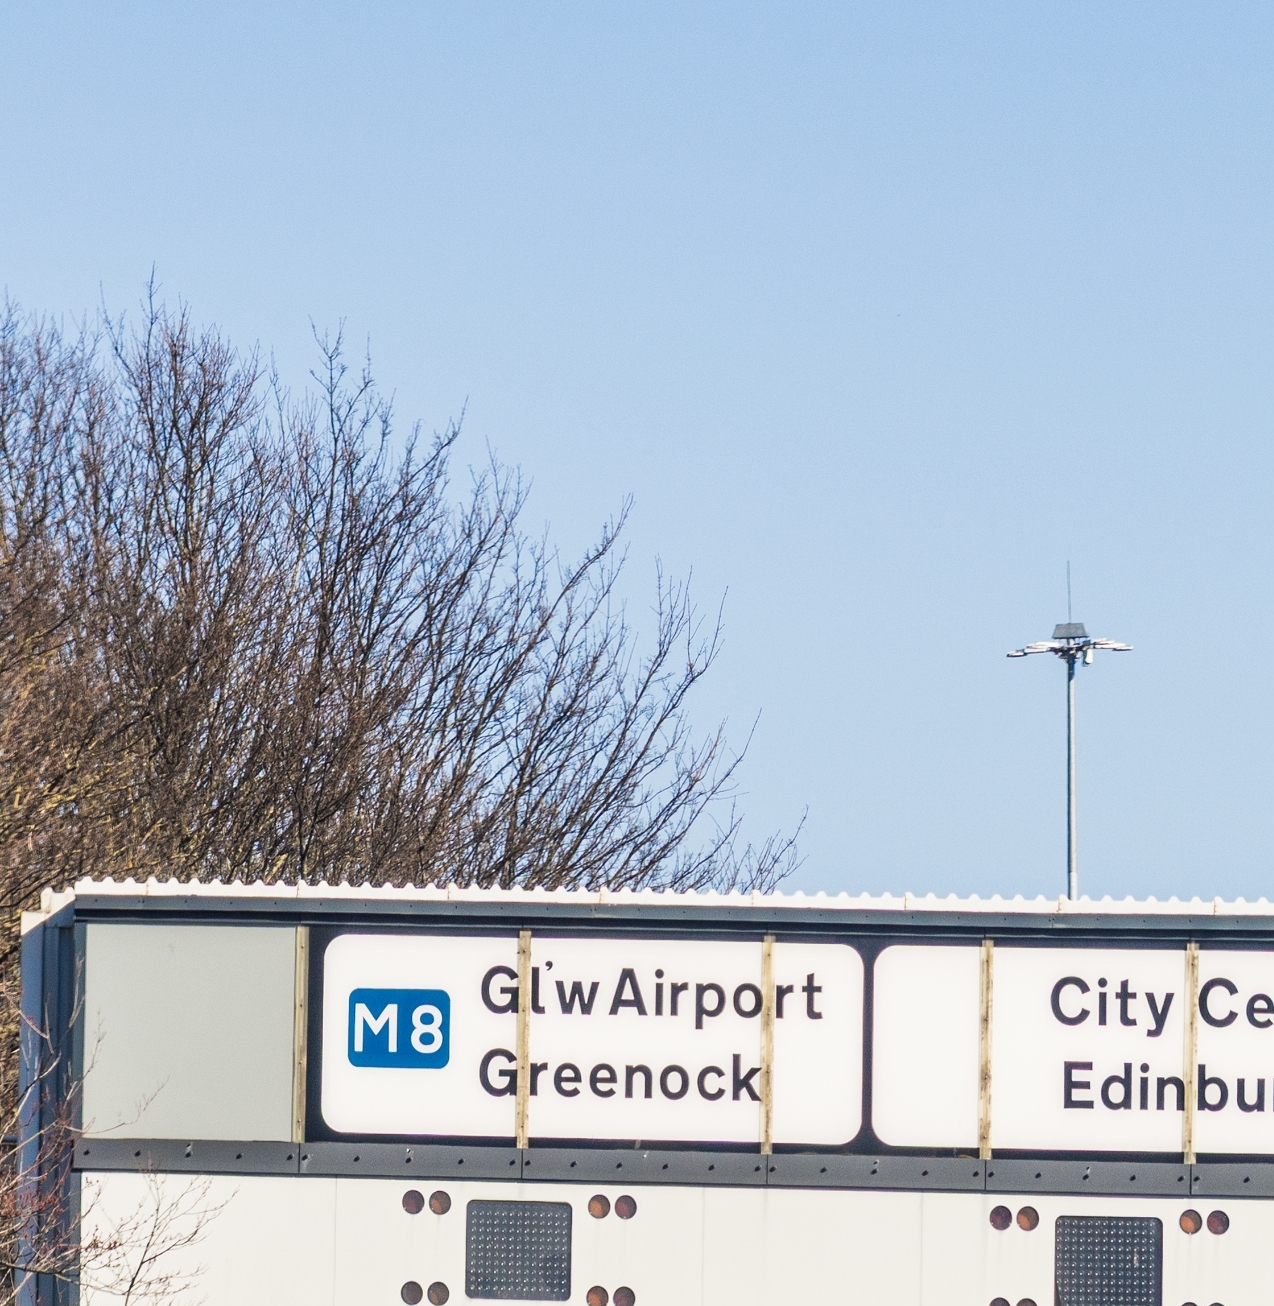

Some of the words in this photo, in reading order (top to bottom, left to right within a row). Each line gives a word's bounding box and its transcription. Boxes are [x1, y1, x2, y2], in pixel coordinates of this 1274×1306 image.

[480, 961, 600, 1016] Gl'w
[608, 967, 824, 1030] Airport
[1050, 976, 1175, 1037] City
[353, 1003, 444, 1055] M8
[479, 1047, 764, 1102] Greenock
